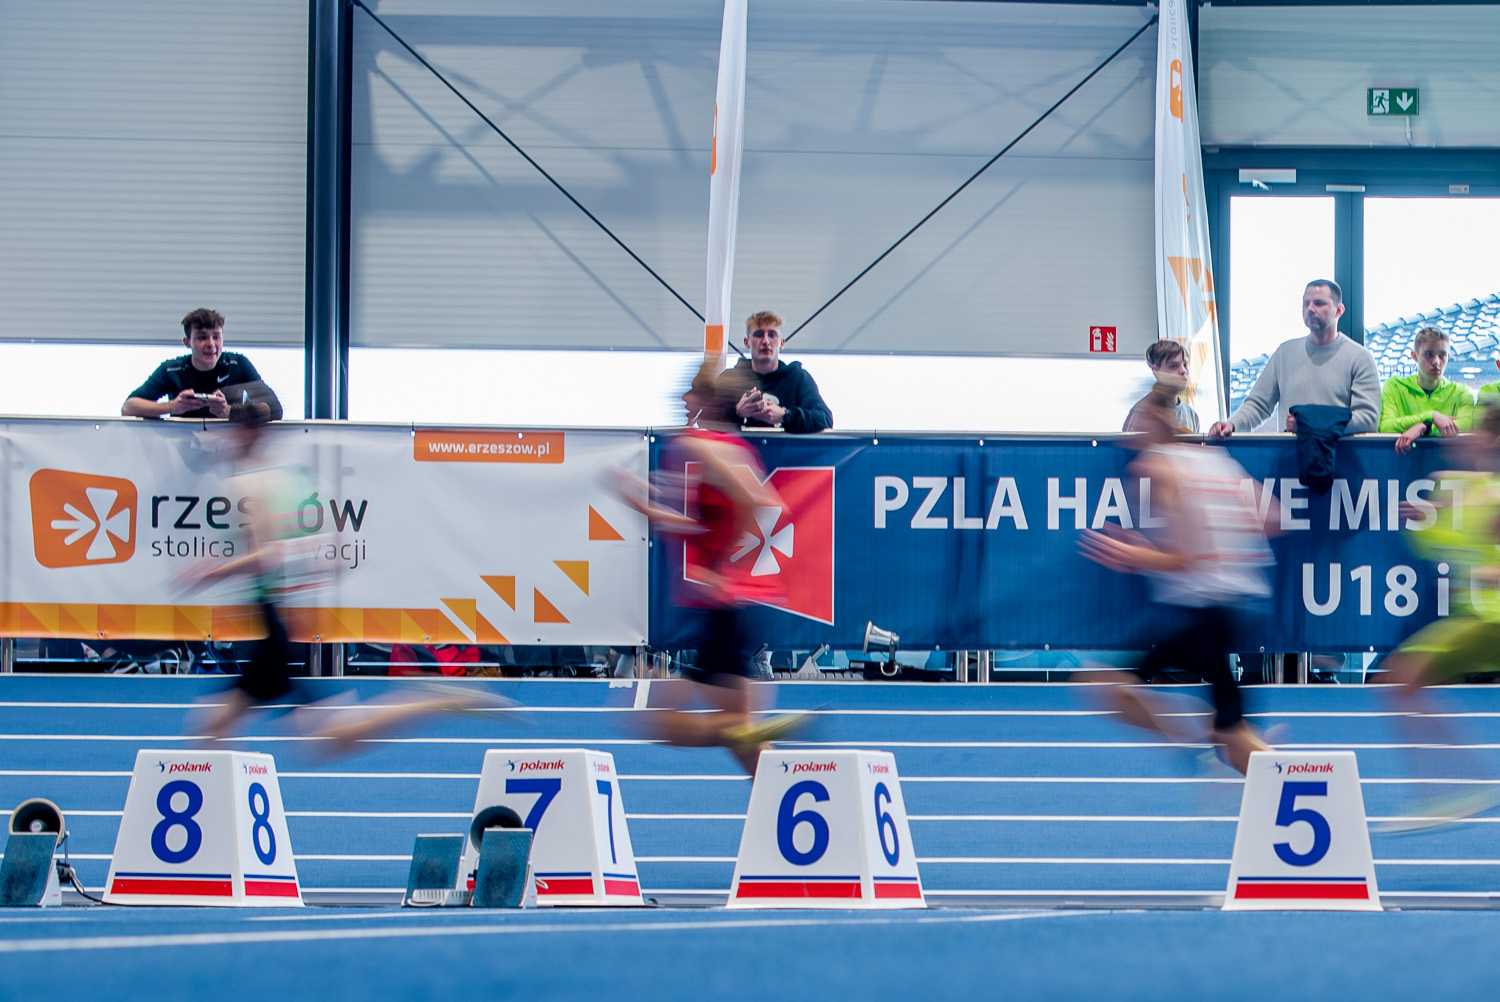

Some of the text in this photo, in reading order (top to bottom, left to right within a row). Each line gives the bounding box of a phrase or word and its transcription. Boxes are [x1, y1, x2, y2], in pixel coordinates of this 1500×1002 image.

[428, 442, 550, 458] www.erzeszow.pl
[151, 491, 368, 533] rzesów
[873, 476, 1029, 530] PZLA
[1047, 477, 1311, 531] HALE
[152, 535, 235, 558] stolica
[1302, 562, 1419, 617] U18
[1437, 562, 1450, 617] i
[169, 761, 213, 774] polanik
[519, 759, 565, 773] polanik
[792, 761, 838, 774] polanik
[1287, 762, 1334, 775] polanik
[151, 780, 204, 864] 8
[248, 782, 277, 866] 8
[505, 778, 562, 852] 7
[596, 779, 617, 865] 7
[777, 780, 830, 866] 6
[874, 782, 900, 867] 6
[1273, 781, 1331, 867] 5
